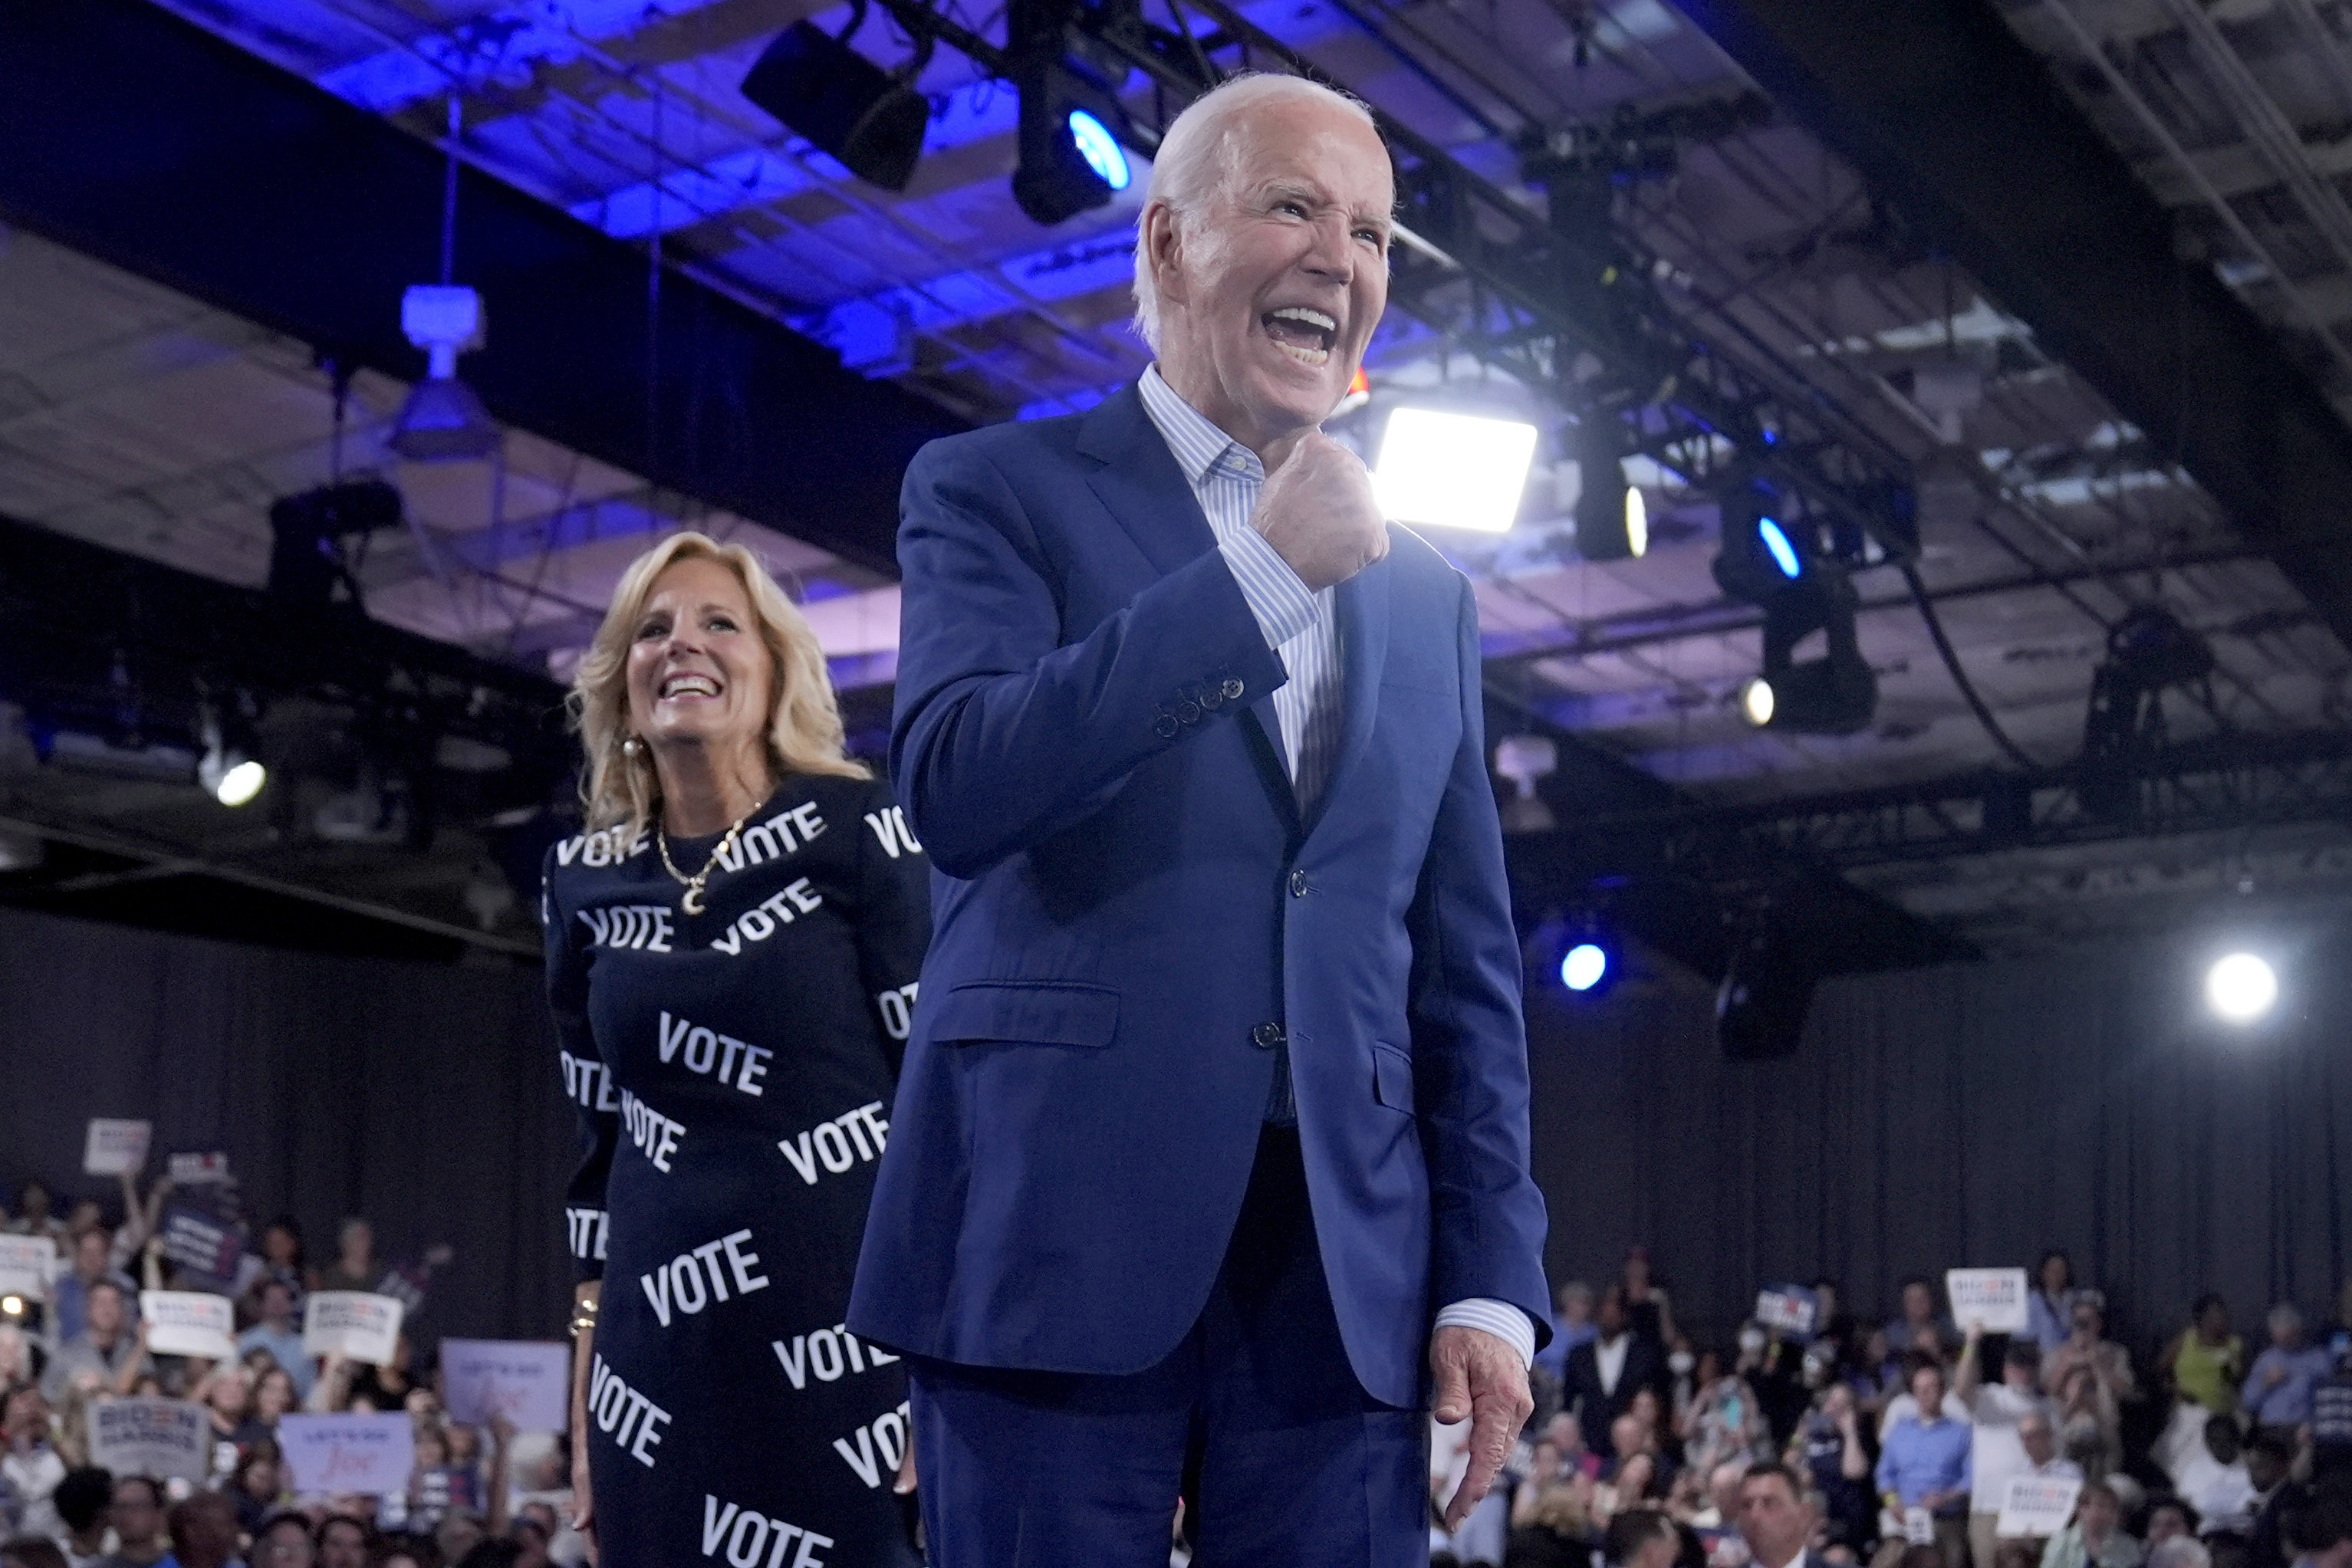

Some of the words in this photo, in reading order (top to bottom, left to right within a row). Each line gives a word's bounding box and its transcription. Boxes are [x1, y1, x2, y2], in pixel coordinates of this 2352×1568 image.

[712, 800, 827, 873] VOTE
[863, 805, 923, 858] VO
[577, 906, 675, 952] VOTE
[711, 877, 823, 956] VOTE
[560, 1050, 619, 1112] OTE
[658, 1011, 773, 1097] VOTE
[619, 1085, 686, 1175] VOTE
[777, 1100, 890, 1186] VOTE
[640, 1228, 770, 1328] VOTE
[589, 1352, 672, 1468] VOTE
[701, 1494, 834, 1568] VOTE
